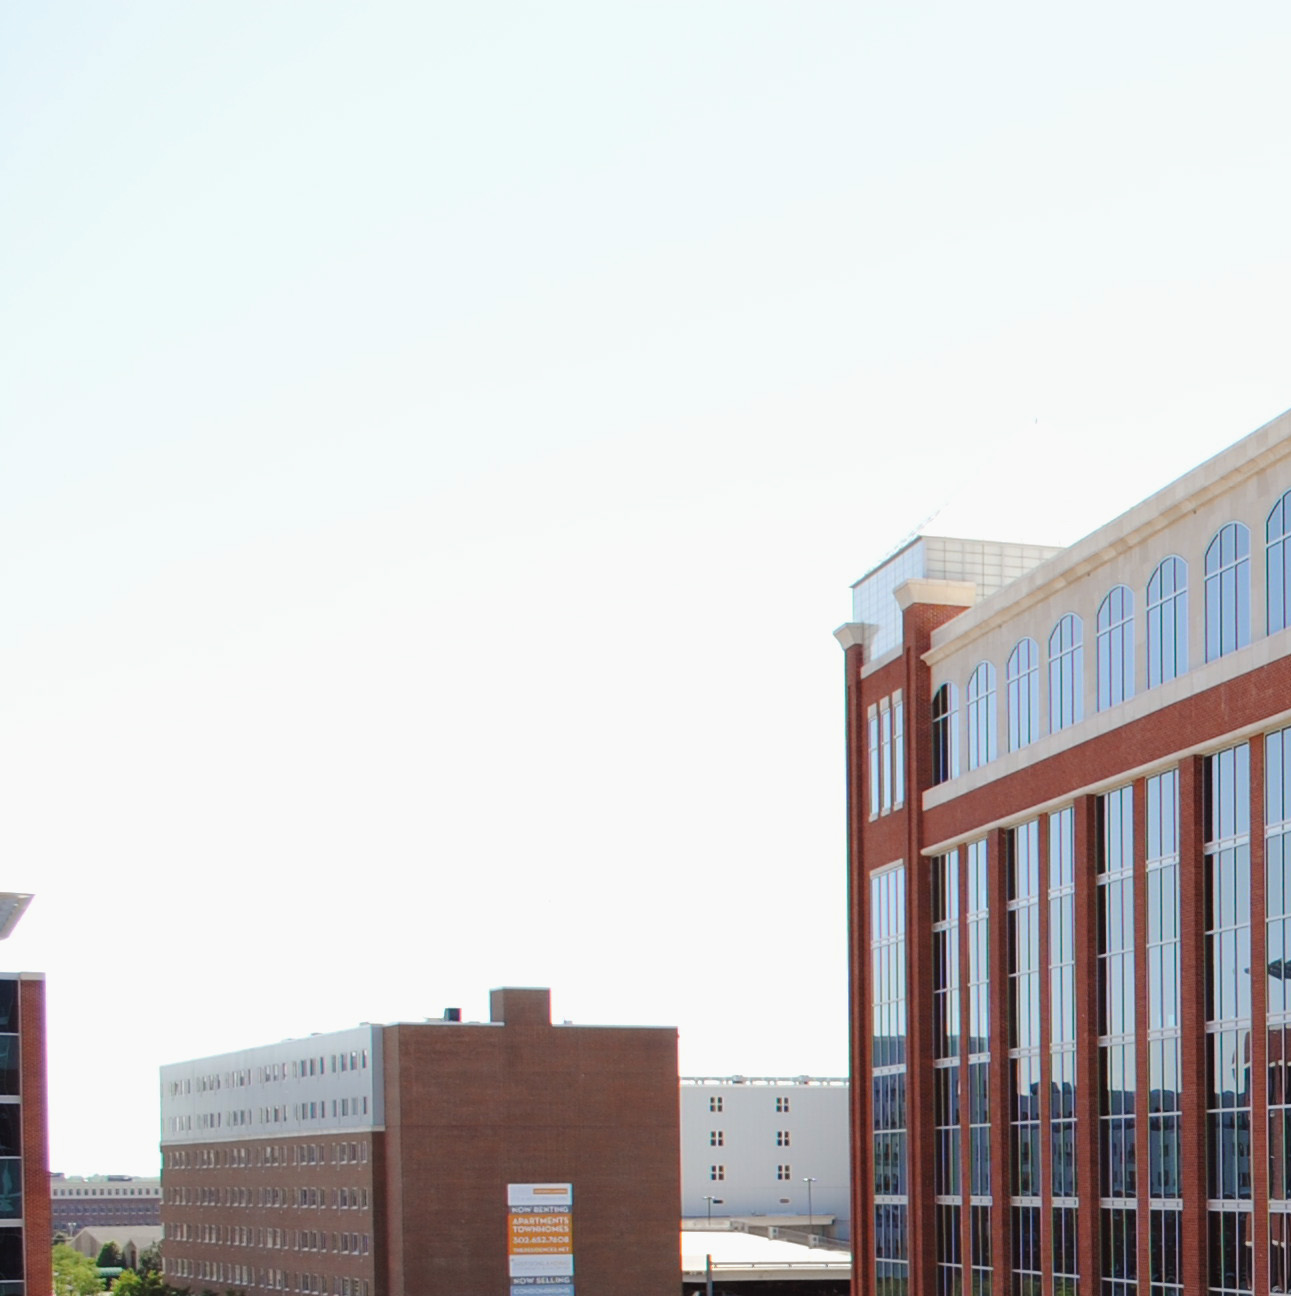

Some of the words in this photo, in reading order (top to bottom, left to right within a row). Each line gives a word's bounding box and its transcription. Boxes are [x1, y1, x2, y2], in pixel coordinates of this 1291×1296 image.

[533, 1205, 569, 1213] RENTING
[512, 1216, 569, 1225] APARTMENTS
[512, 1225, 569, 1233] TOWNHOMES
[513, 1277, 535, 1285] NOW
[535, 1276, 571, 1284] SELLING
